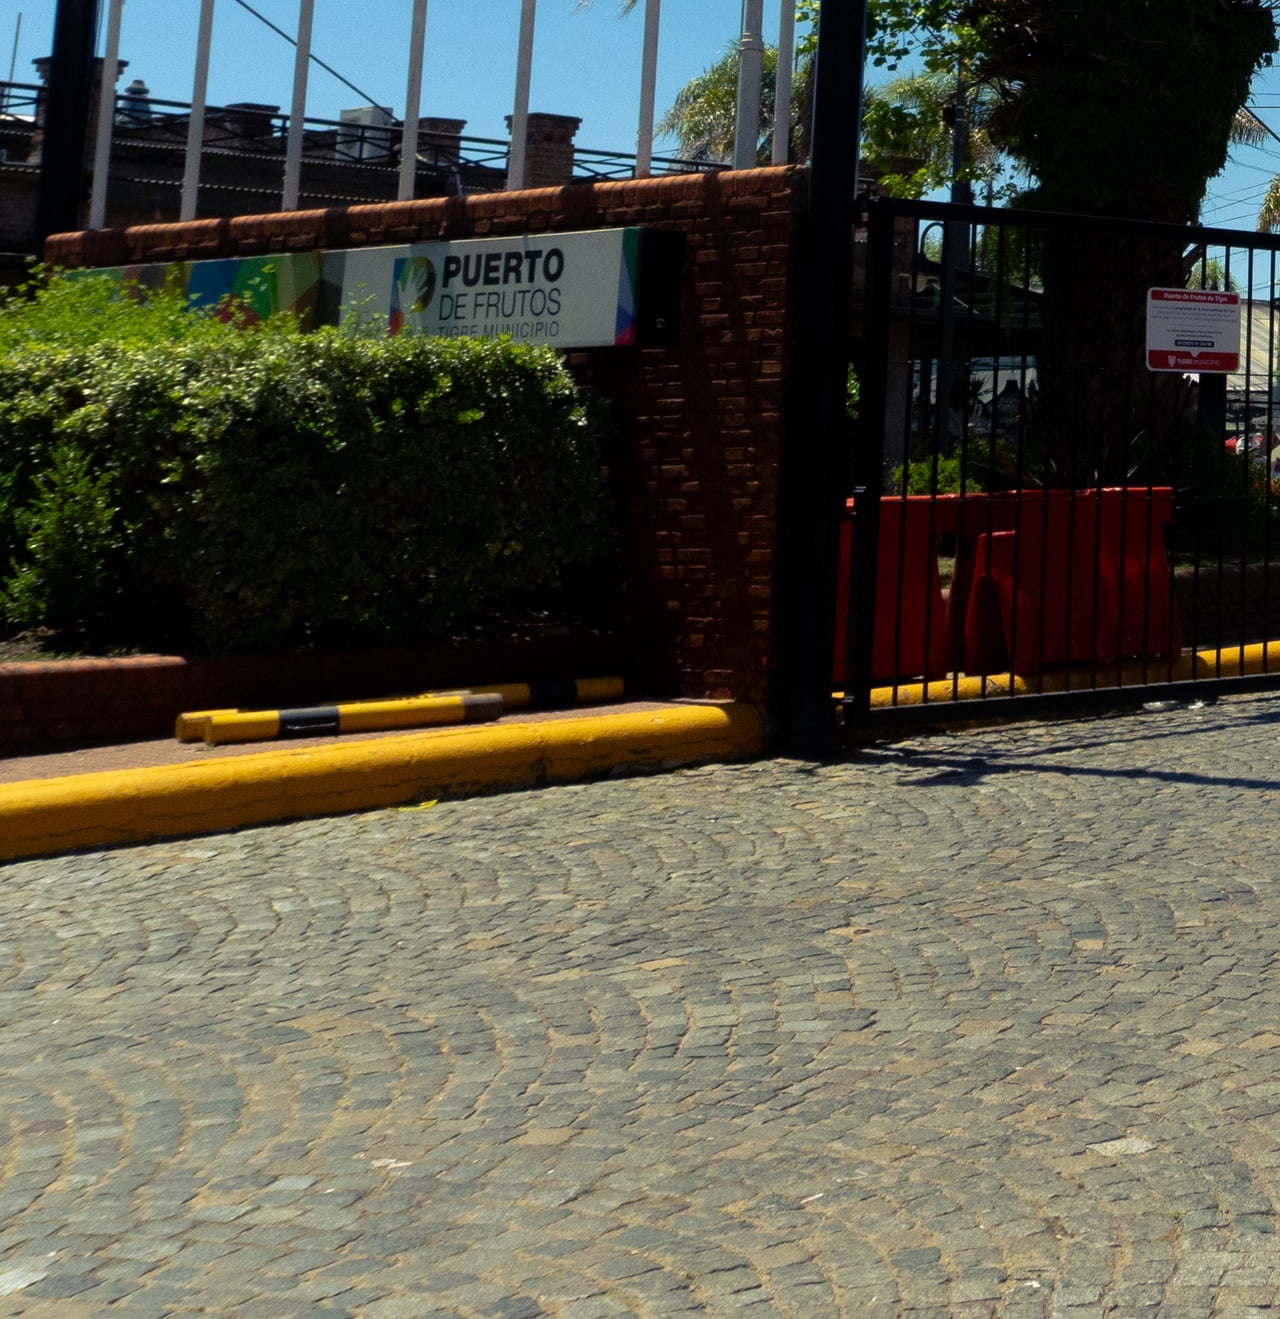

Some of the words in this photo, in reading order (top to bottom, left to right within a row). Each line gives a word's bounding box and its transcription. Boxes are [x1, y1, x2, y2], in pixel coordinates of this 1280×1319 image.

[442, 248, 565, 288] PUERTO
[438, 292, 468, 321] DE
[472, 287, 562, 319] FRUTOS
[1190, 293, 1207, 301] Frutos
[1215, 295, 1228, 303] Tigre
[483, 321, 560, 339] MUNICIPIO
